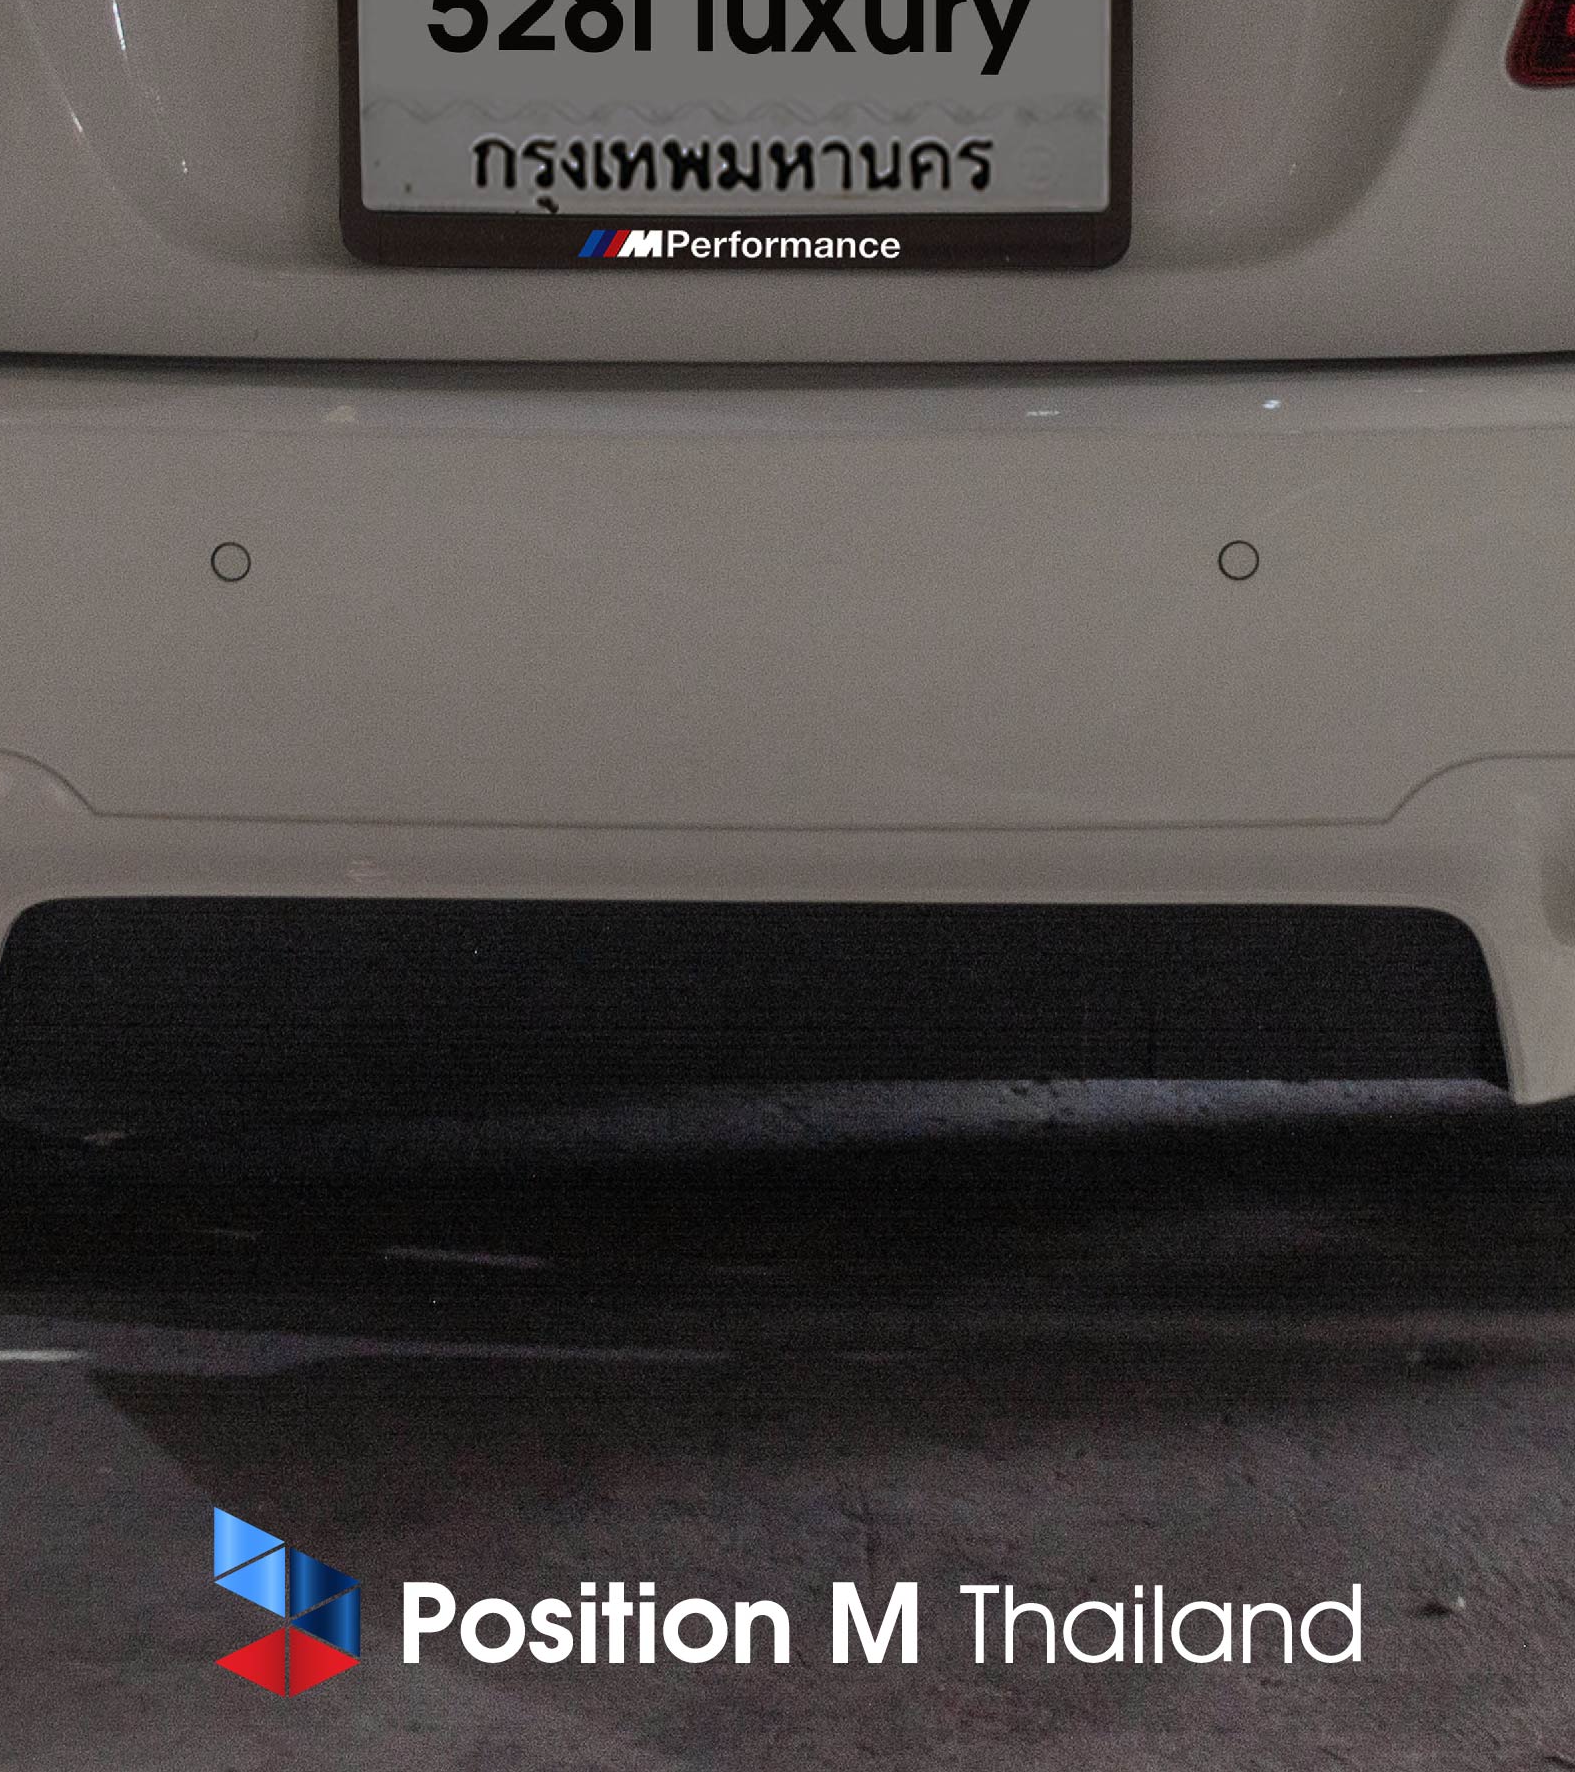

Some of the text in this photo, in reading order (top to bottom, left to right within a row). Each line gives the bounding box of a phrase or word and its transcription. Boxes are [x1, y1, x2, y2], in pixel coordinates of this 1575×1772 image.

[472, 136, 994, 214] กรุงเทพมหานคร
